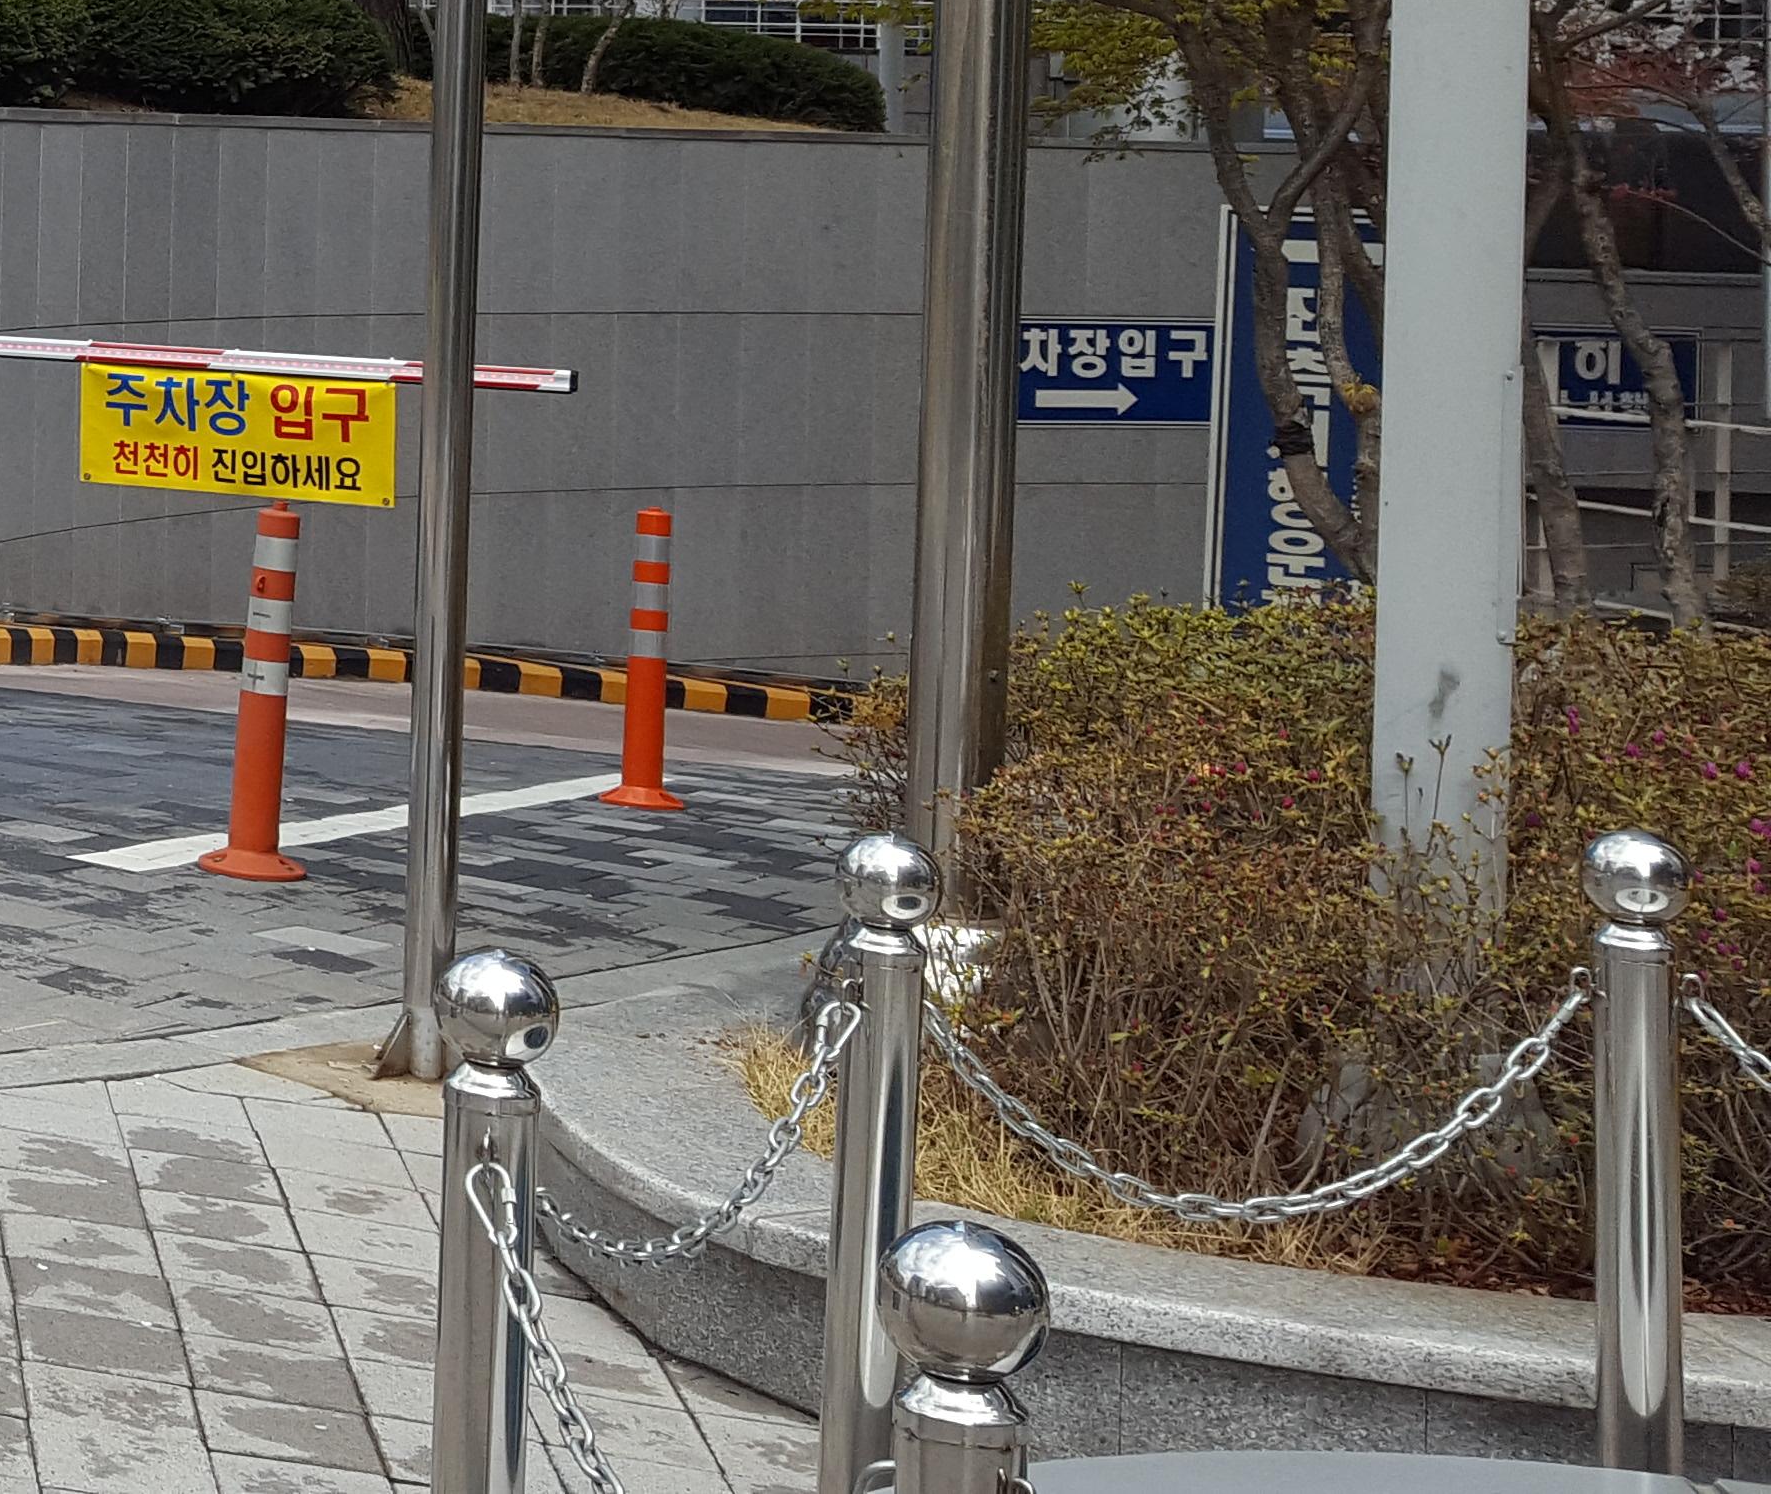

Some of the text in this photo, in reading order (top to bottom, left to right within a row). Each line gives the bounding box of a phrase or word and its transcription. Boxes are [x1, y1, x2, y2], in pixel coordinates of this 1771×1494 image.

[106, 373, 369, 443] 주차장 입구
[112, 440, 362, 492] 천천히 진입하세요
